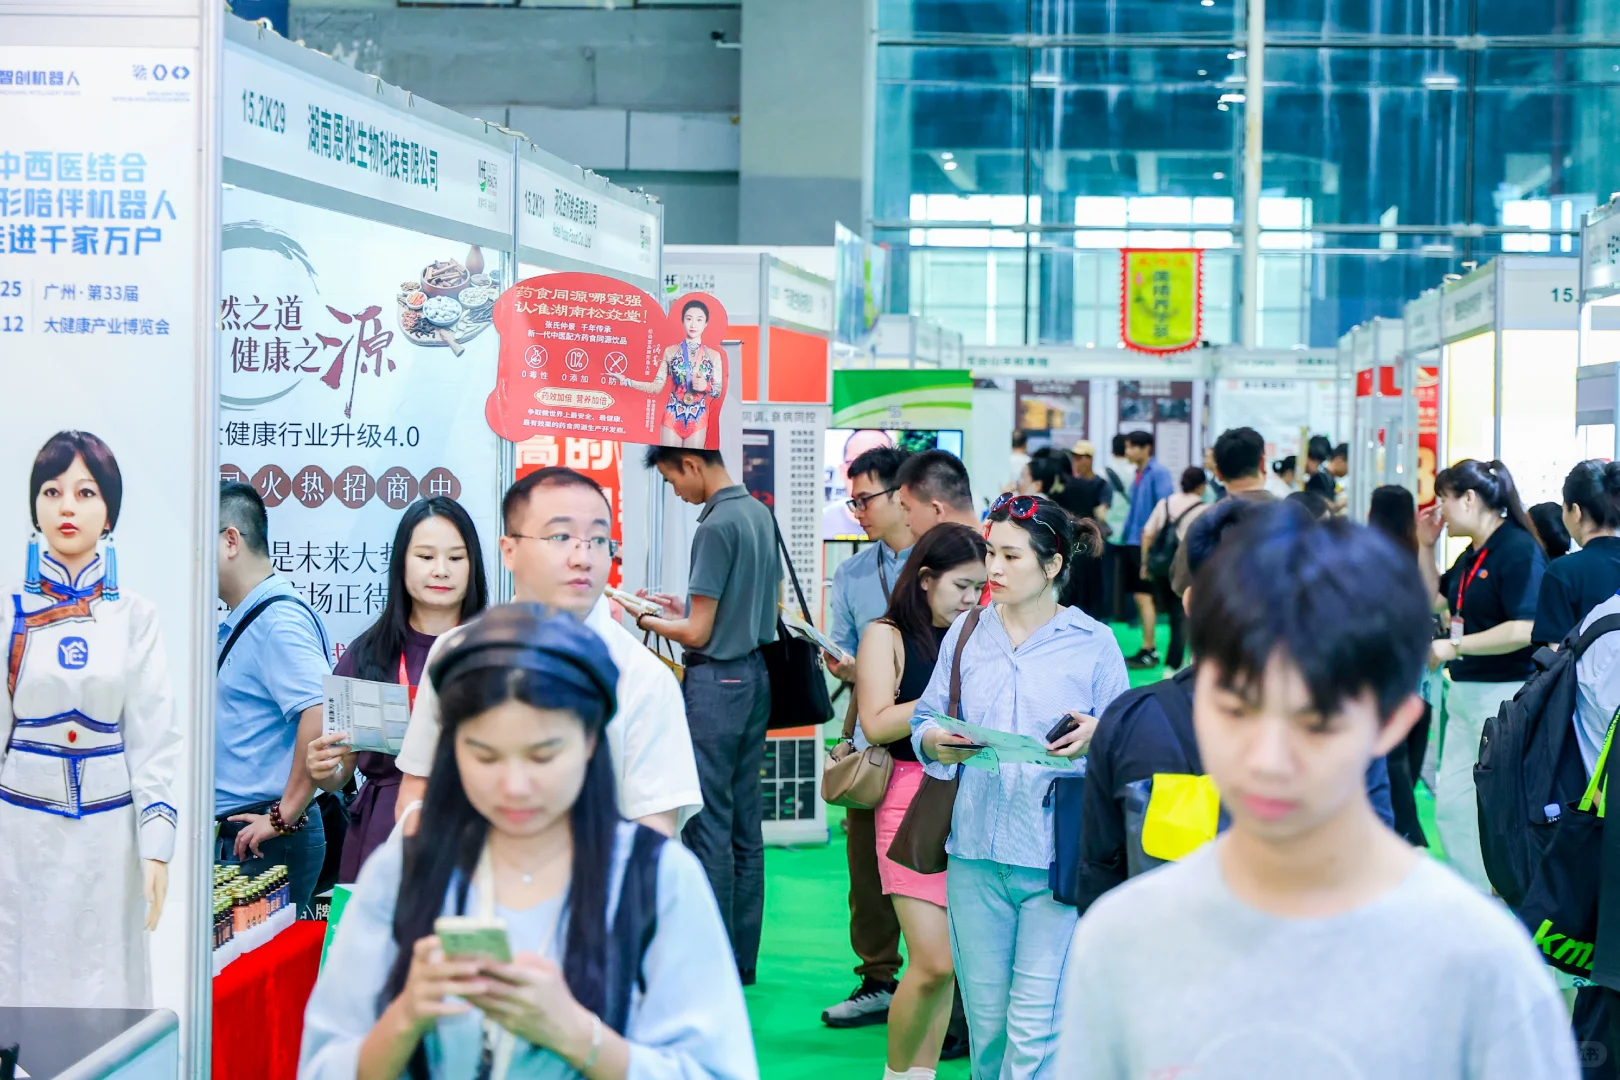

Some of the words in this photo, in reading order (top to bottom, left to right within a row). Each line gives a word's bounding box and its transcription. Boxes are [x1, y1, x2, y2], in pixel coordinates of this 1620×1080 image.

[0, 70, 80, 86] 智创机器人
[242, 88, 286, 134] 15.2K29
[308, 104, 438, 192] 湖南恩松生物科技有限公司
[0, 150, 147, 183] 中西医结合
[0, 188, 177, 220] 形陪伴机器人
[0, 224, 162, 256] 进千家万户
[515, 286, 643, 308] 药食同源哪家强
[44, 317, 170, 335] 大健康产业博览会
[527, 331, 628, 346] 新一代中医配方药食同源饮品
[544, 320, 576, 331] 张氏仲景
[581, 323, 612, 334] 千年传承
[541, 391, 573, 403] 药效加倍
[576, 394, 608, 406] 营养加倍
[218, 421, 420, 448] 健康行业升级4.0
[1532, 918, 1595, 971] km
